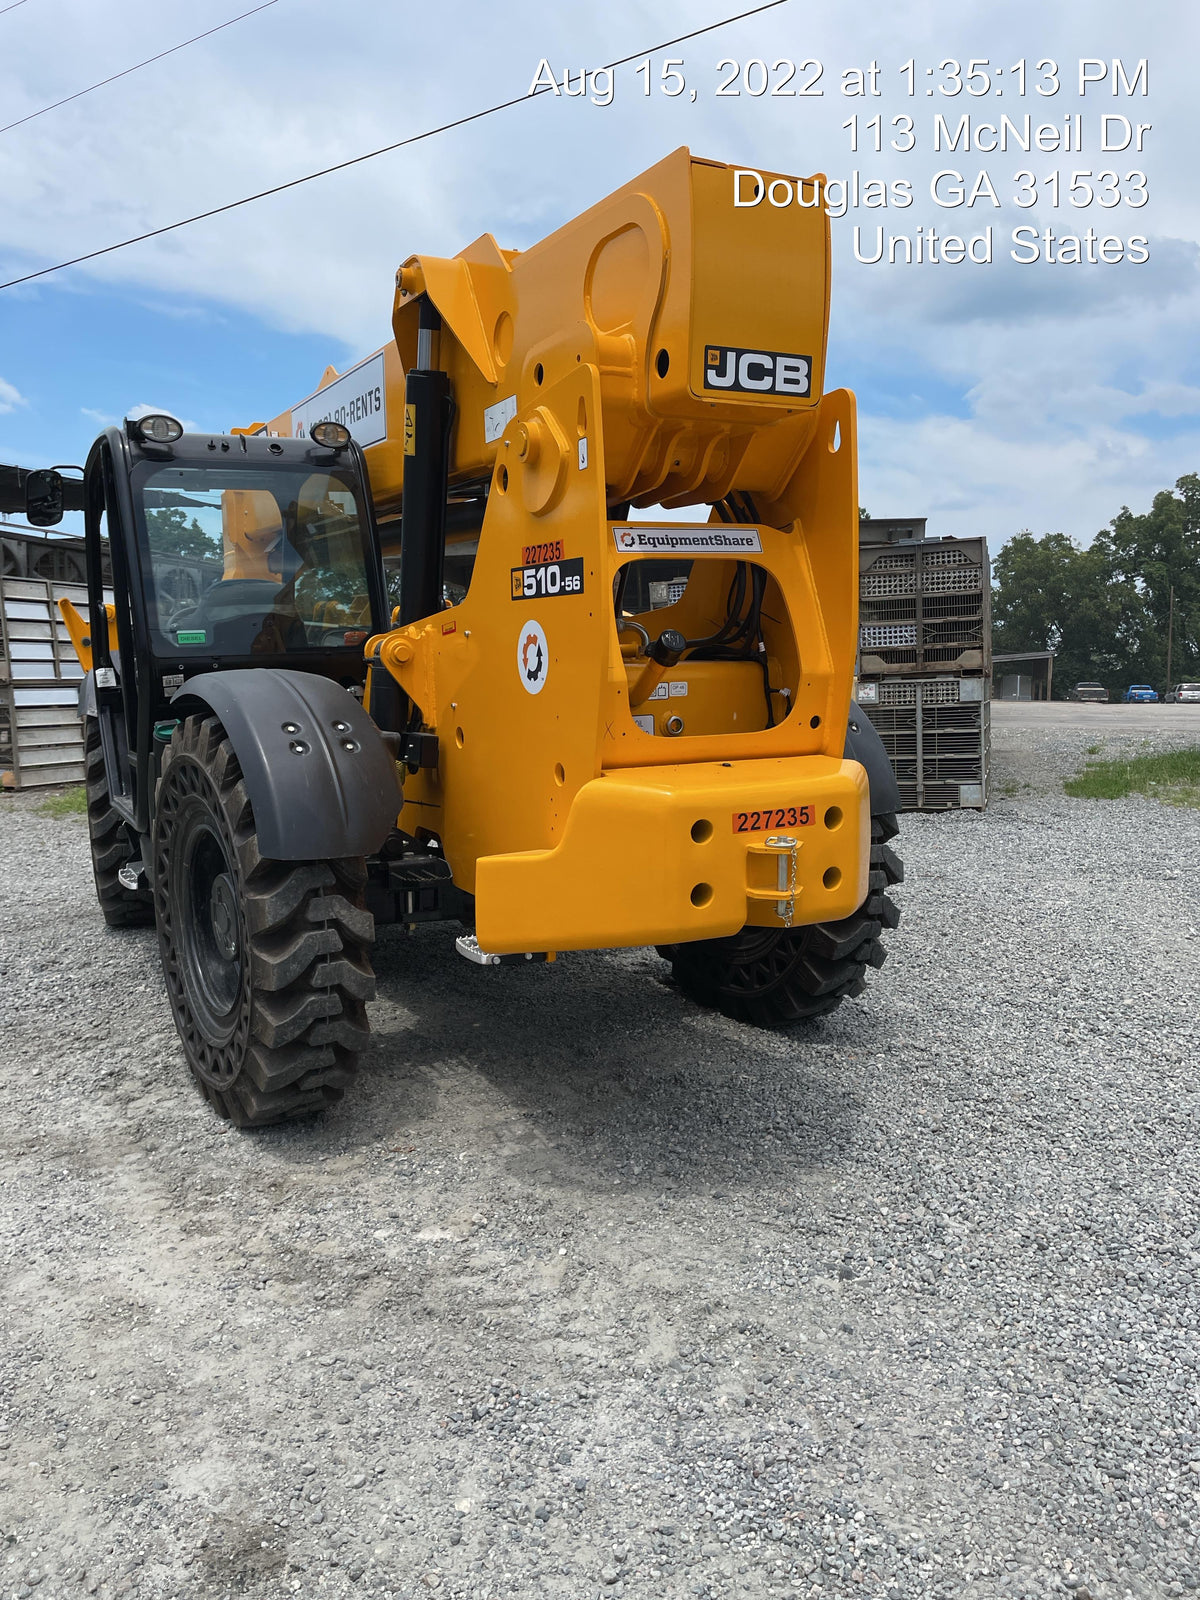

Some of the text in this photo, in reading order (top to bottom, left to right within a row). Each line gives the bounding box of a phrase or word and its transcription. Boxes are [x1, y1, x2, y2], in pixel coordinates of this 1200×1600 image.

[707, 351, 809, 394] JCB
[525, 541, 561, 565] 227235
[637, 534, 754, 548] EquipmentShare
[737, 805, 810, 832] 227235
